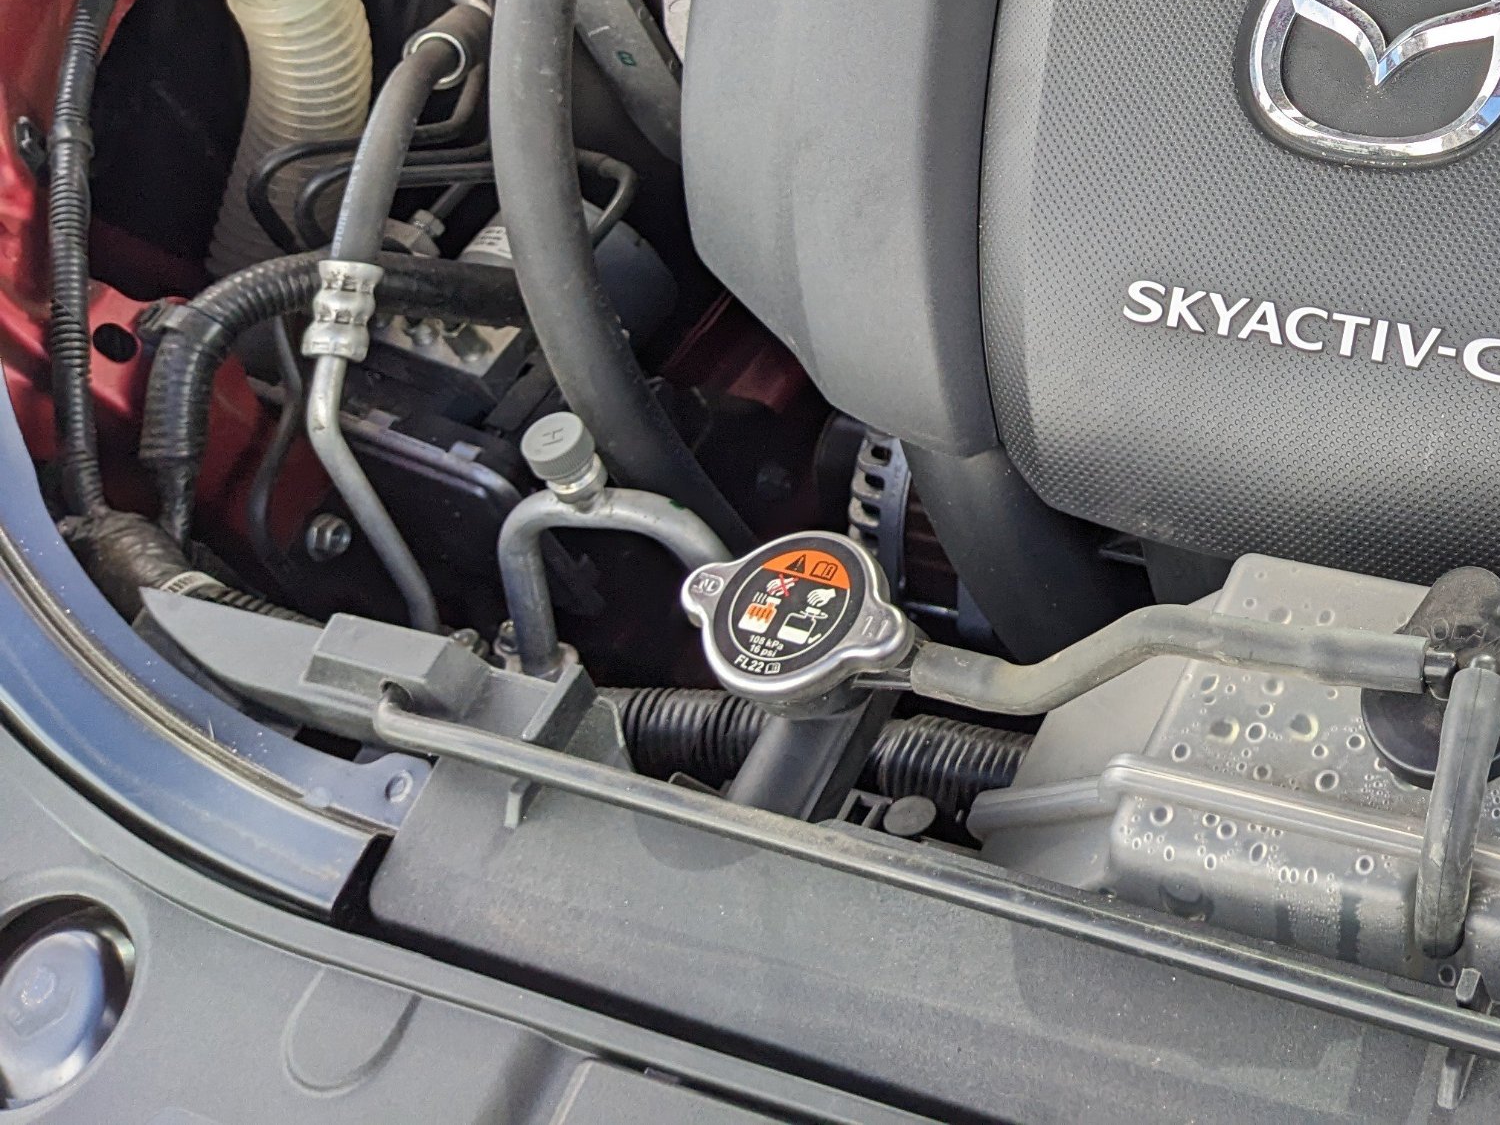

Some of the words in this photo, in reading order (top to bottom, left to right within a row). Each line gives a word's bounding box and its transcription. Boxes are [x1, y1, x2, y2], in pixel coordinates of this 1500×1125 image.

[749, 634, 766, 645] 108
[765, 638, 784, 651] kPa
[750, 644, 761, 654] 16
[760, 648, 778, 657] psi
[734, 654, 765, 673] FL22
